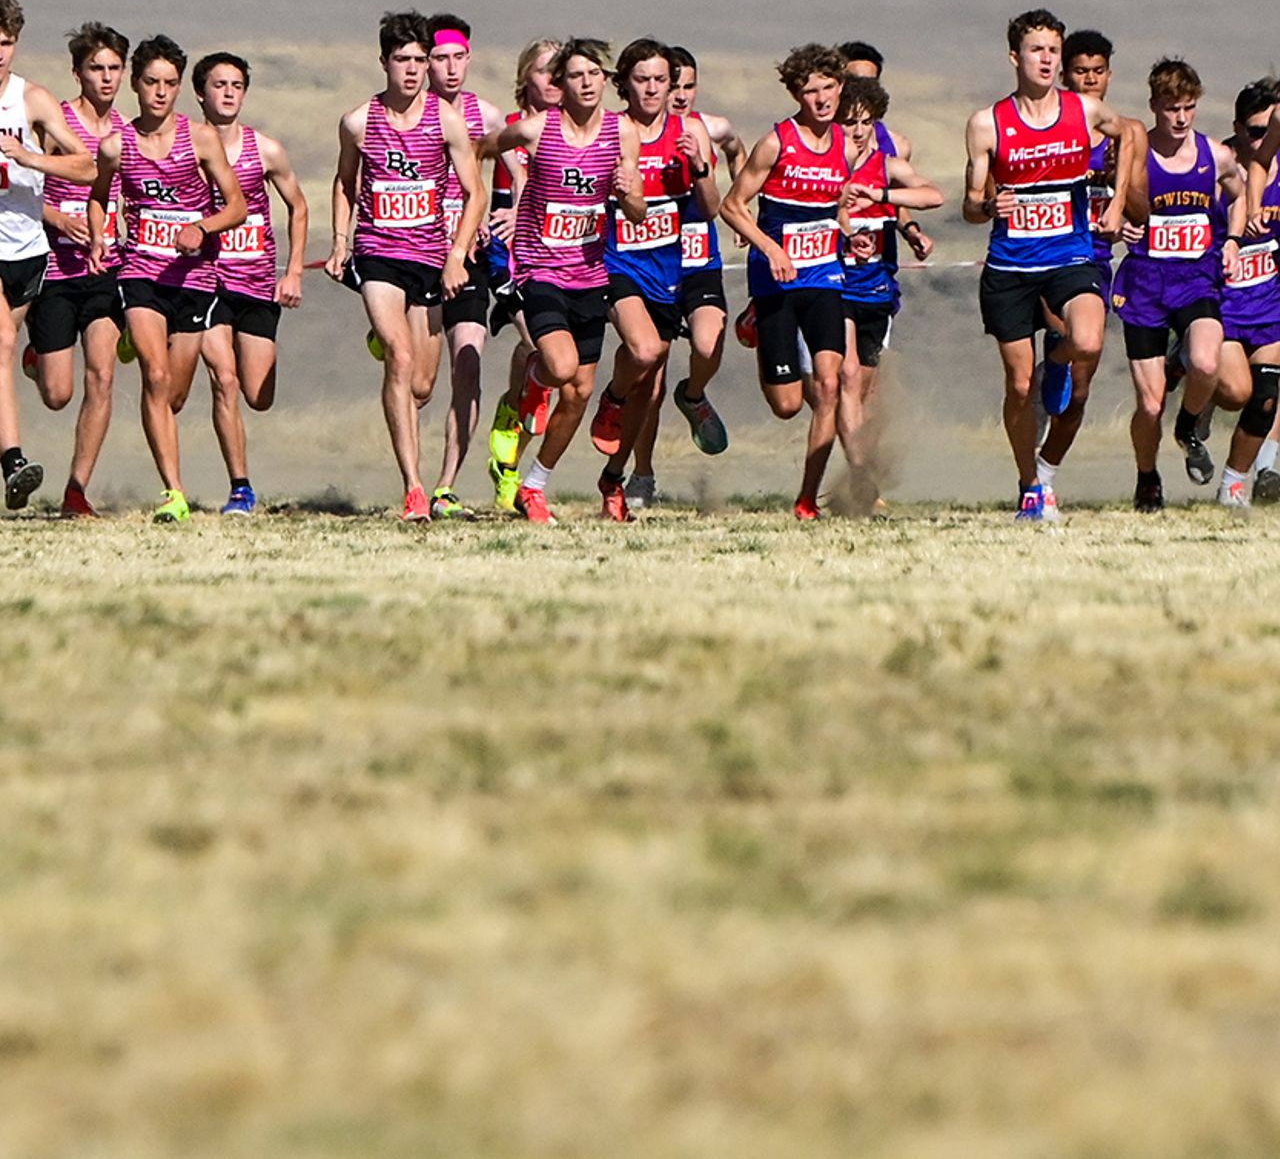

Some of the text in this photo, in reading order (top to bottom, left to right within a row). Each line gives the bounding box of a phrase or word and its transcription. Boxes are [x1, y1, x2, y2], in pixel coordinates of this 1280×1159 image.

[386, 149, 420, 181] BK
[143, 179, 181, 204] BK
[562, 166, 598, 195] BK
[378, 192, 430, 220] 0303
[1153, 191, 1211, 210] EWISTON
[549, 215, 597, 239] 0306
[622, 215, 673, 243] 0539
[1013, 203, 1067, 230] 0528
[144, 221, 183, 248] 030
[221, 227, 258, 251] 304
[787, 230, 833, 259] 0537
[1154, 226, 1205, 251] 0512
